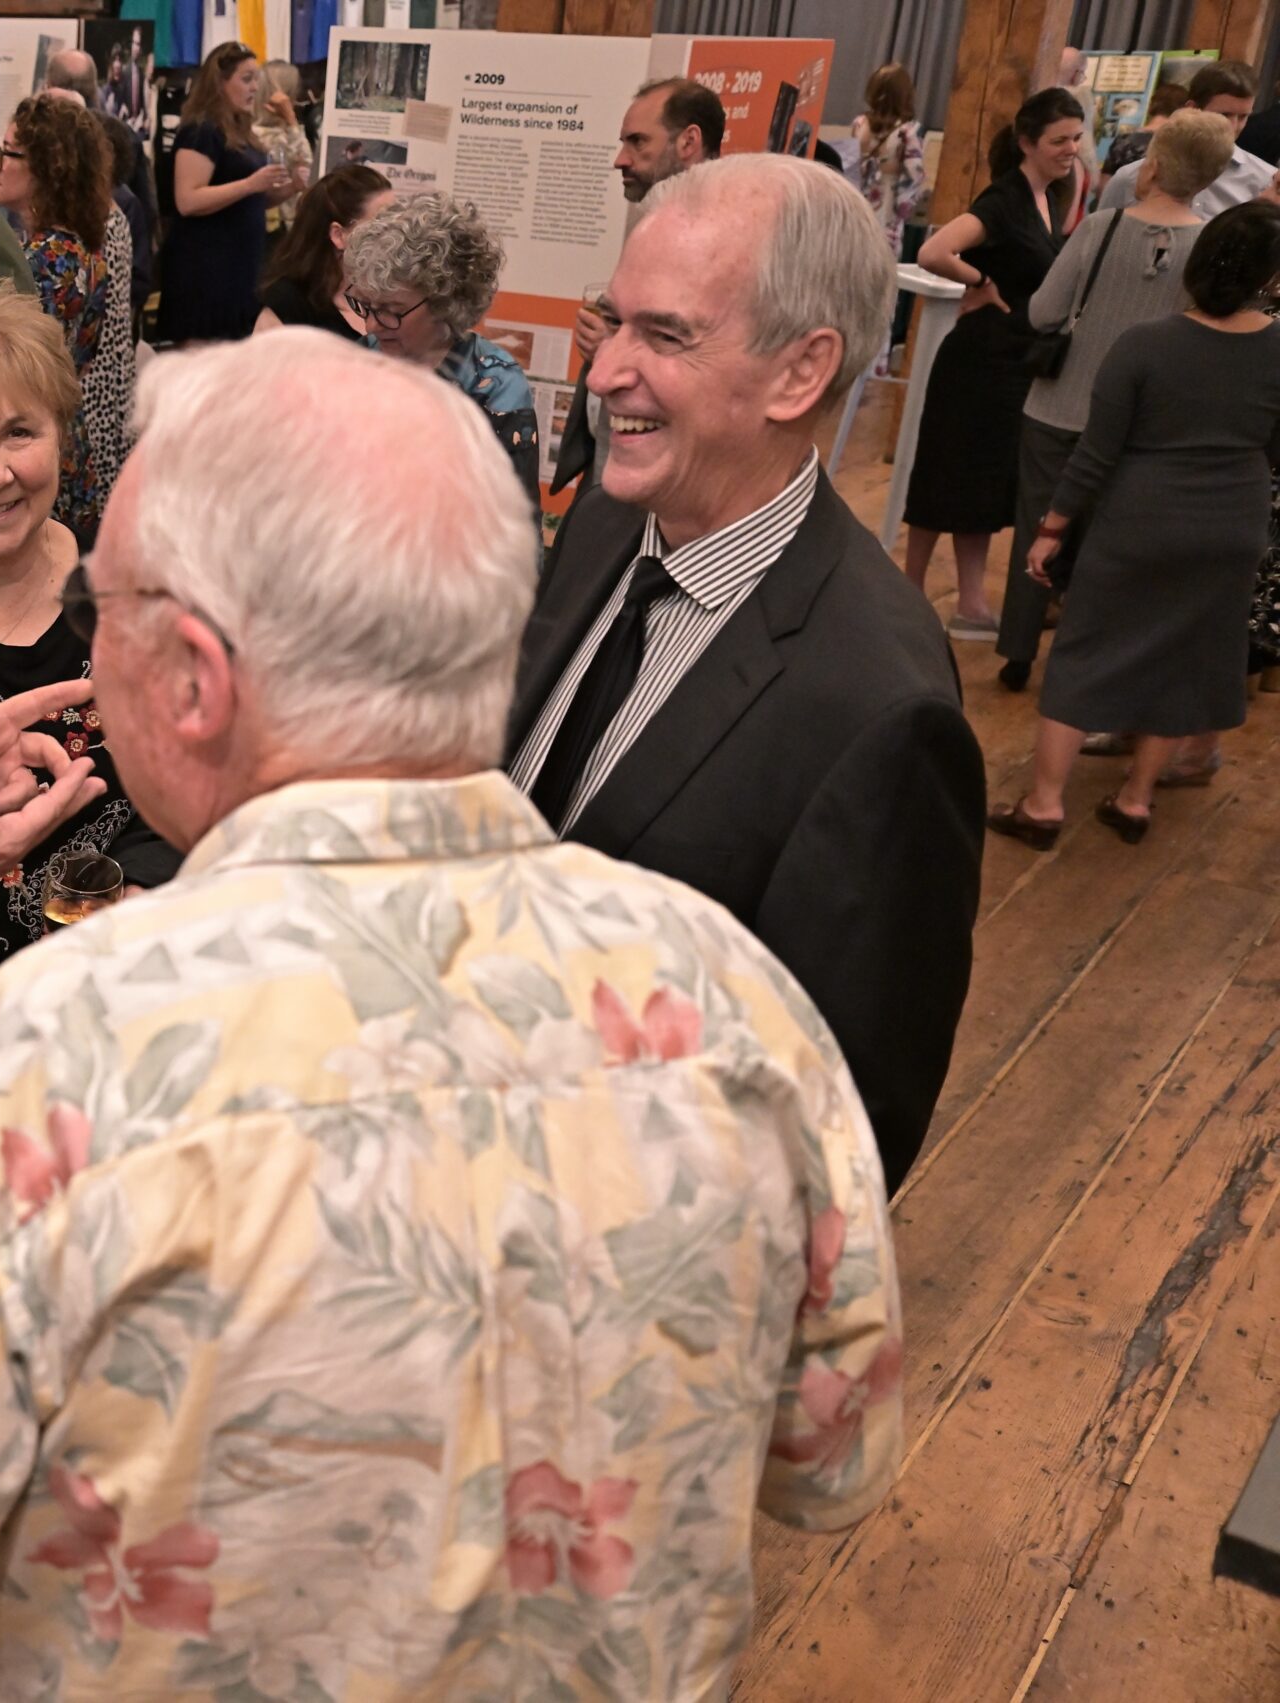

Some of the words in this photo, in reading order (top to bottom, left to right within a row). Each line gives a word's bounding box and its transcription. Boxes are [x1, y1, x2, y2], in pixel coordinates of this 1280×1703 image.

[474, 72, 505, 85] 2009
[730, 70, 763, 94] 2019
[461, 98, 503, 112] Largest
[505, 101, 563, 115] expansion
[566, 104, 578, 115] of
[460, 113, 521, 128] Wilderness
[523, 118, 553, 130] since
[557, 119, 584, 131] 1984
